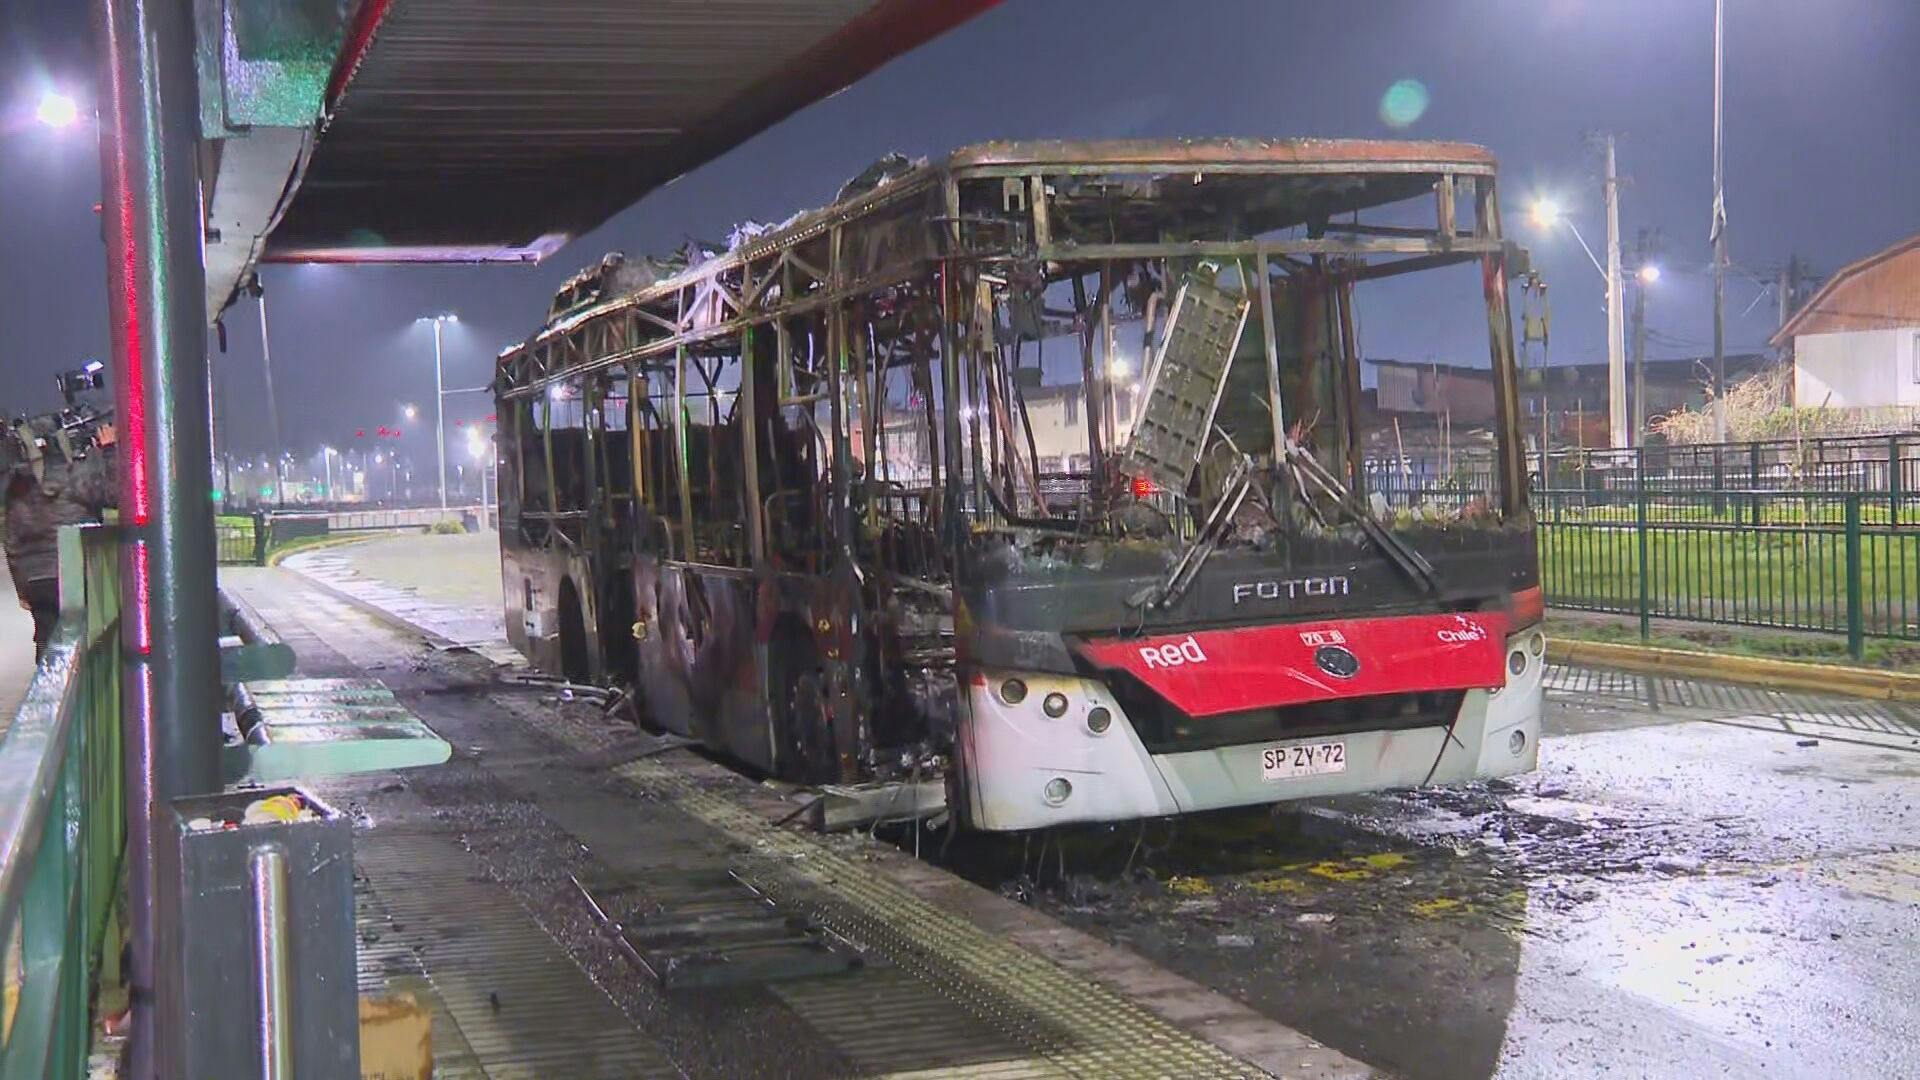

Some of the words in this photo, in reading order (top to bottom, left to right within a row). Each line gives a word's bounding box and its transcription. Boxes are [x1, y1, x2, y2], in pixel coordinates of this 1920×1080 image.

[1233, 576, 1349, 604] FOTON
[1437, 630, 1480, 643] Chile
[1139, 636, 1207, 668] Red
[1264, 749, 1286, 769] SP
[1293, 747, 1315, 766] ZY
[1322, 744, 1343, 763] 72
